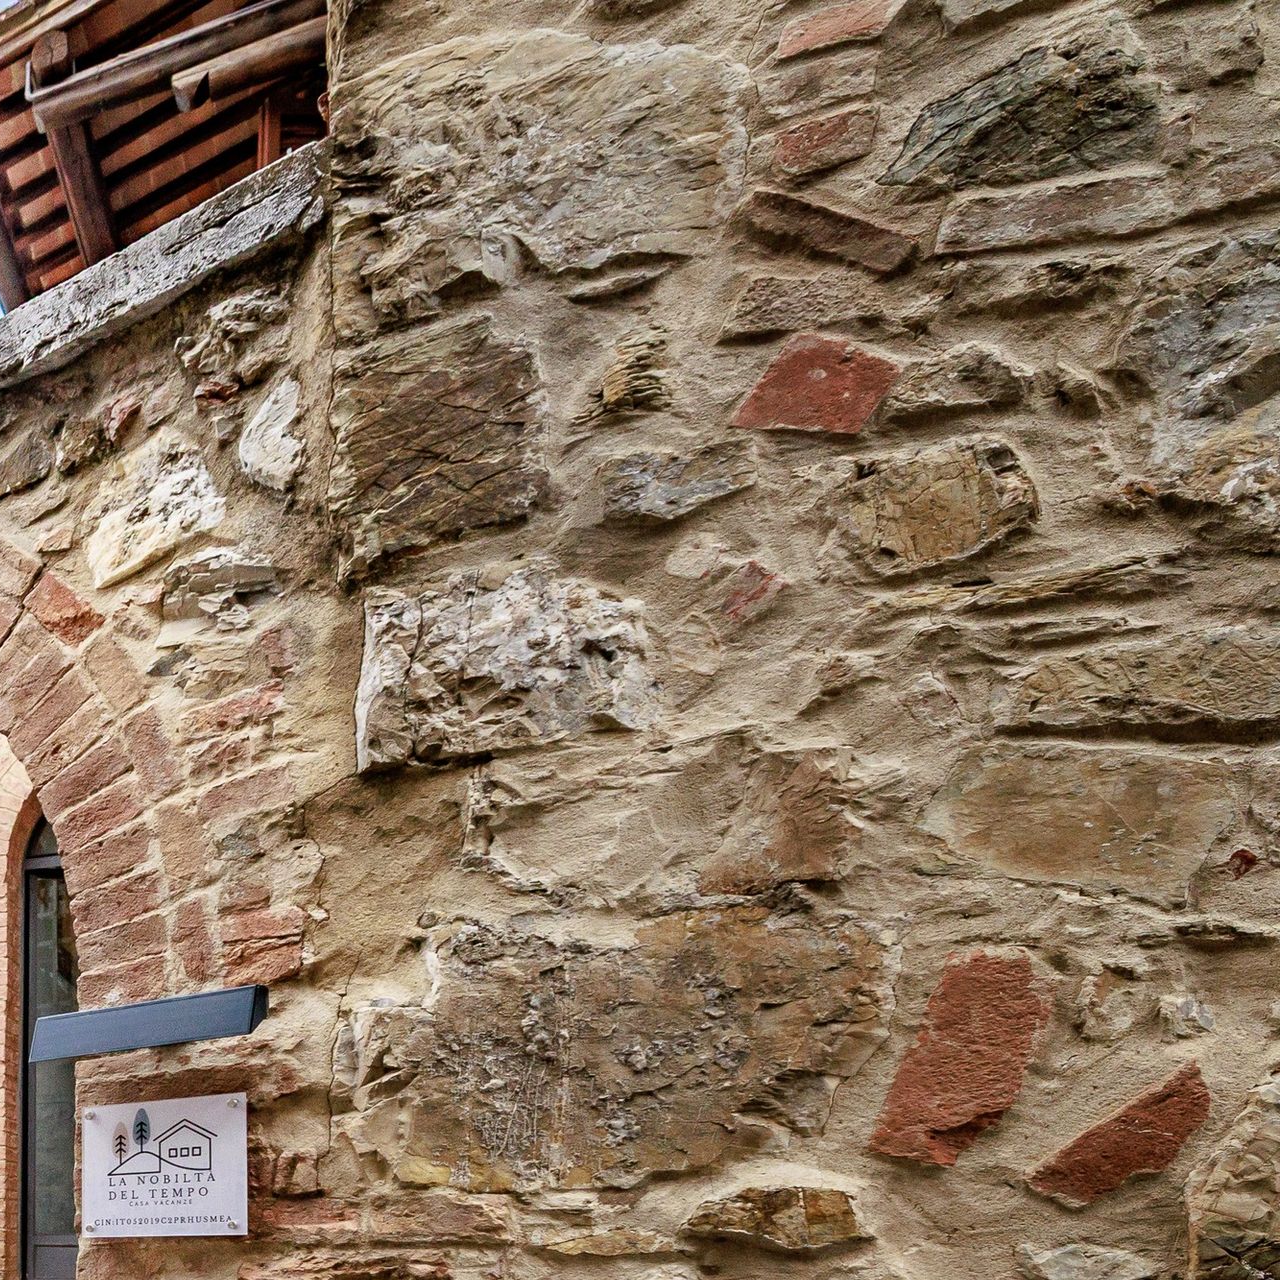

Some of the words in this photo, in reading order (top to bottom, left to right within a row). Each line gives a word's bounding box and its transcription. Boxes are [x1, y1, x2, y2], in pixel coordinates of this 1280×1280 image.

[109, 1177, 127, 1187] LA
[108, 1190, 139, 1201] DEL
[148, 1186, 209, 1199] TEMPO
[154, 1198, 193, 1206] VACANZE
